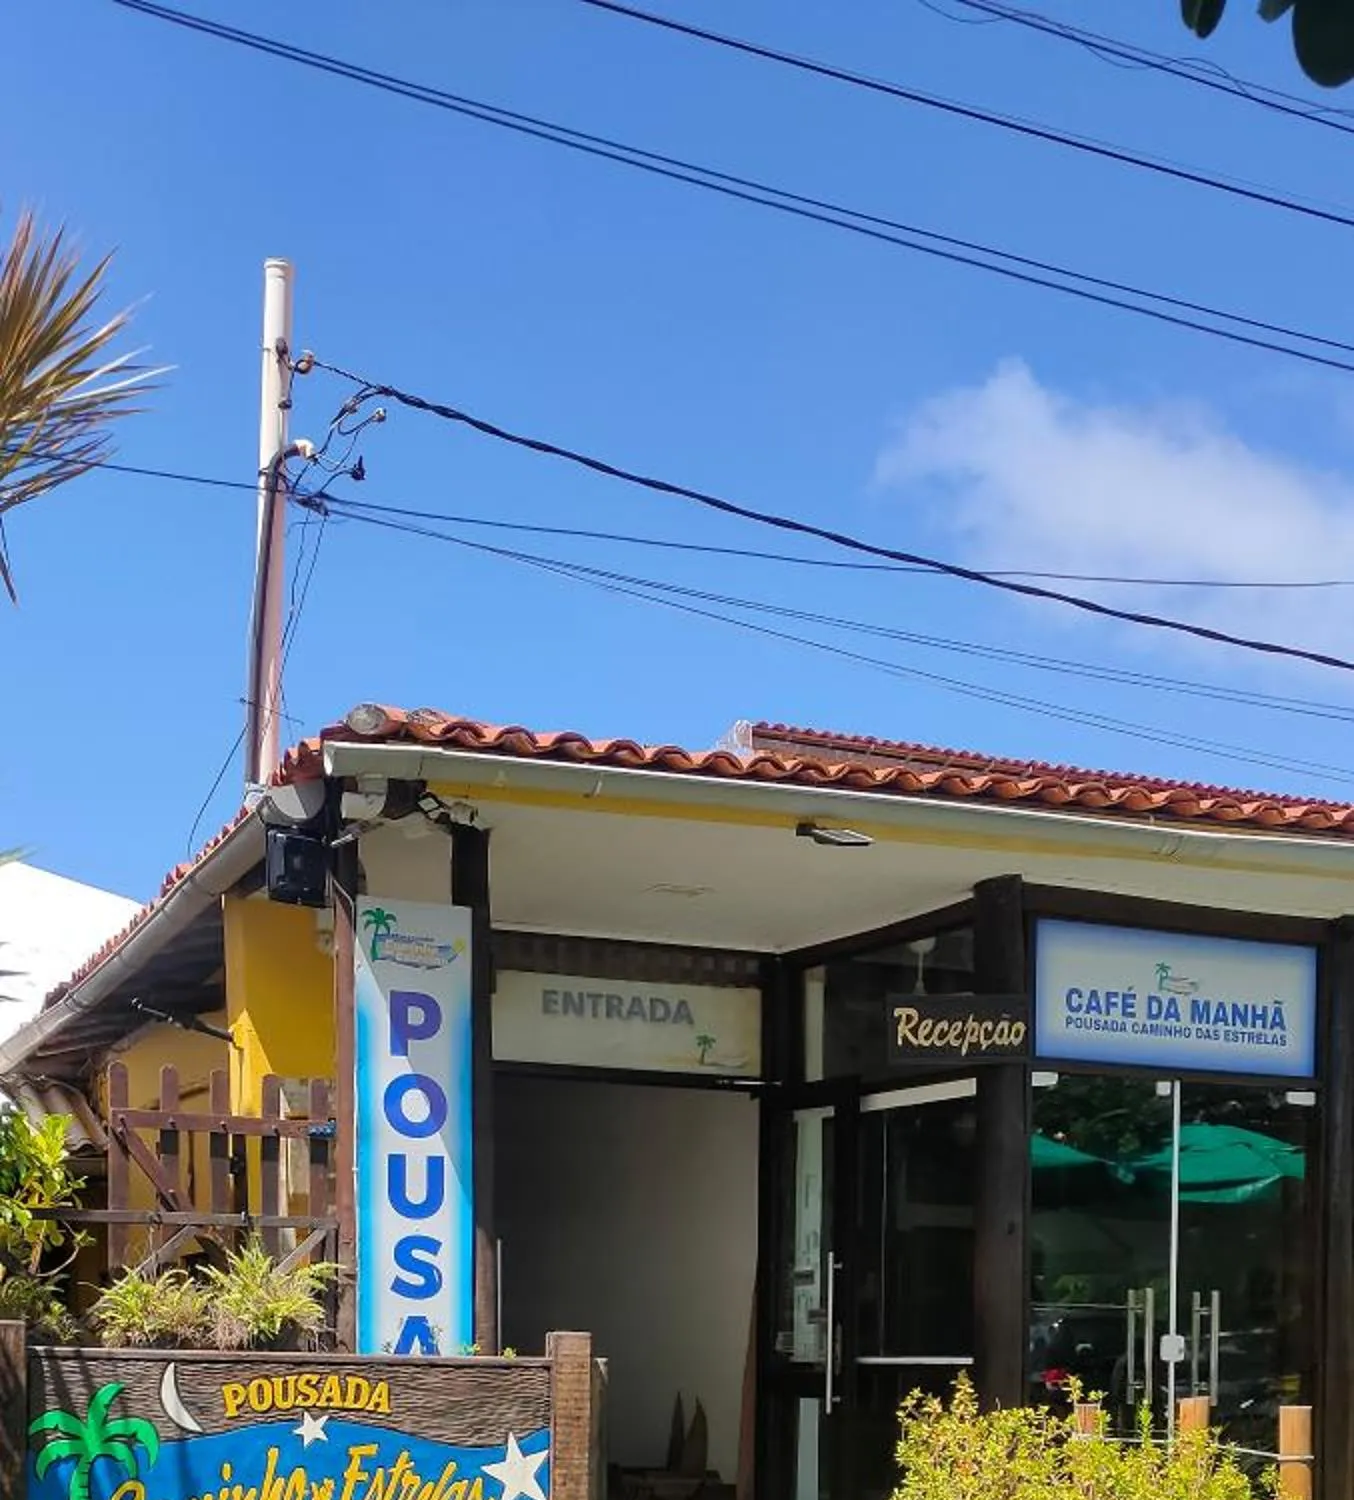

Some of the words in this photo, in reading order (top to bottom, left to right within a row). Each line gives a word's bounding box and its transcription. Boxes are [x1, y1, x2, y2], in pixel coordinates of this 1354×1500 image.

[541, 989, 694, 1025] ENTRADA
[1065, 986, 1137, 1018] CAFÉ
[1147, 995, 1181, 1022] DA
[1191, 999, 1286, 1031] MANHÃ
[893, 1007, 1027, 1056] Recepção
[1065, 1016, 1127, 1033] POUSADA
[1131, 1022, 1192, 1038] CAMINHO
[1195, 1028, 1221, 1041] DAS
[1223, 1031, 1287, 1047] ESTRELAS
[222, 1373, 392, 1418] POUSADA
